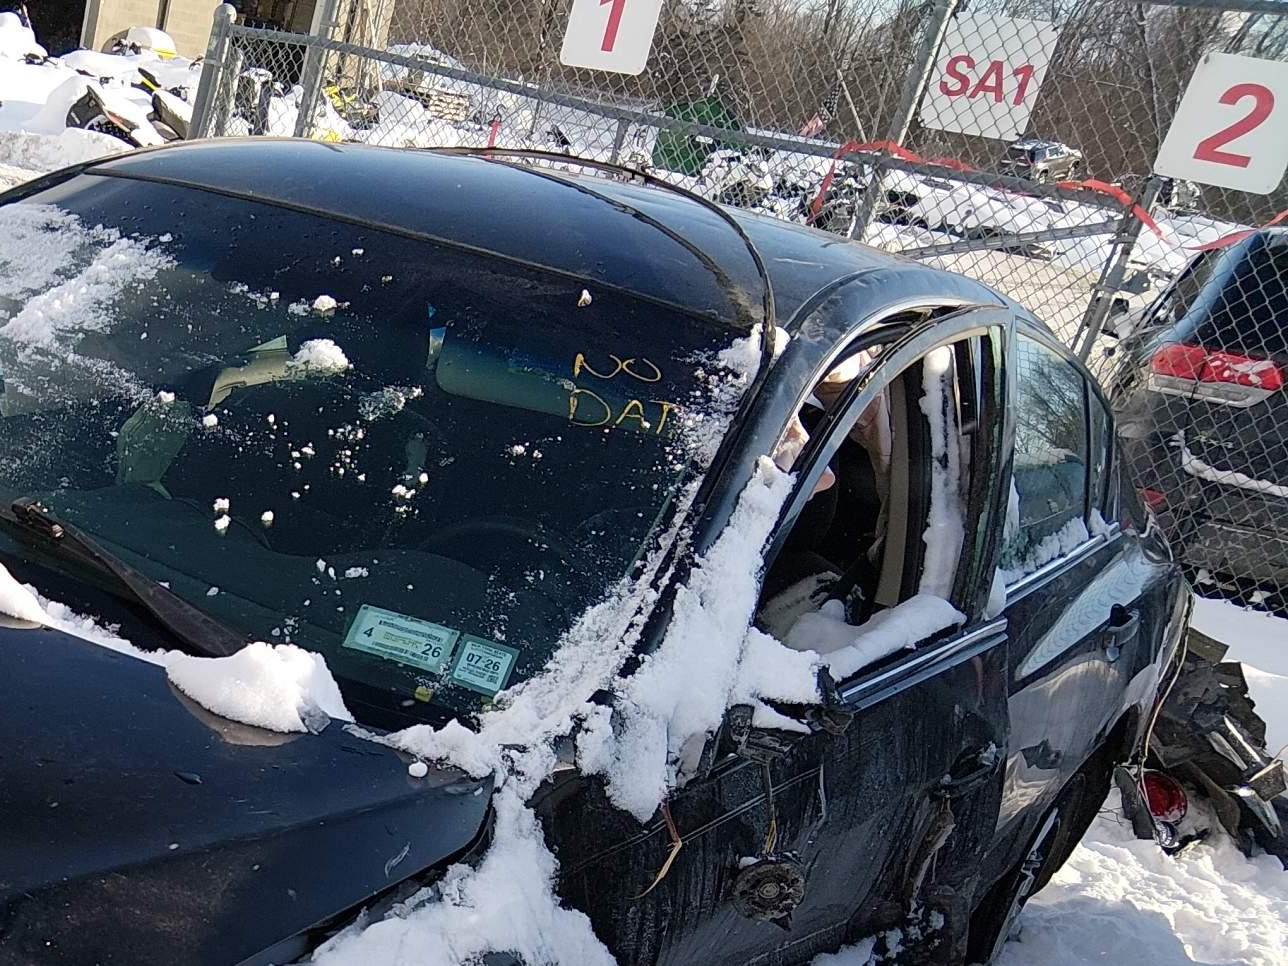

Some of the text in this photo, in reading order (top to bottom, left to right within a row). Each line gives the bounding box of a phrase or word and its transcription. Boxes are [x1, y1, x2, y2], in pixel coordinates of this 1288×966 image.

[599, 0, 626, 52] 1
[939, 55, 1034, 106] SA1
[1193, 83, 1275, 169] 2
[574, 352, 662, 382] NO
[363, 627, 375, 638] 4
[421, 643, 442, 658] 26
[466, 652, 501, 672] 07-26
